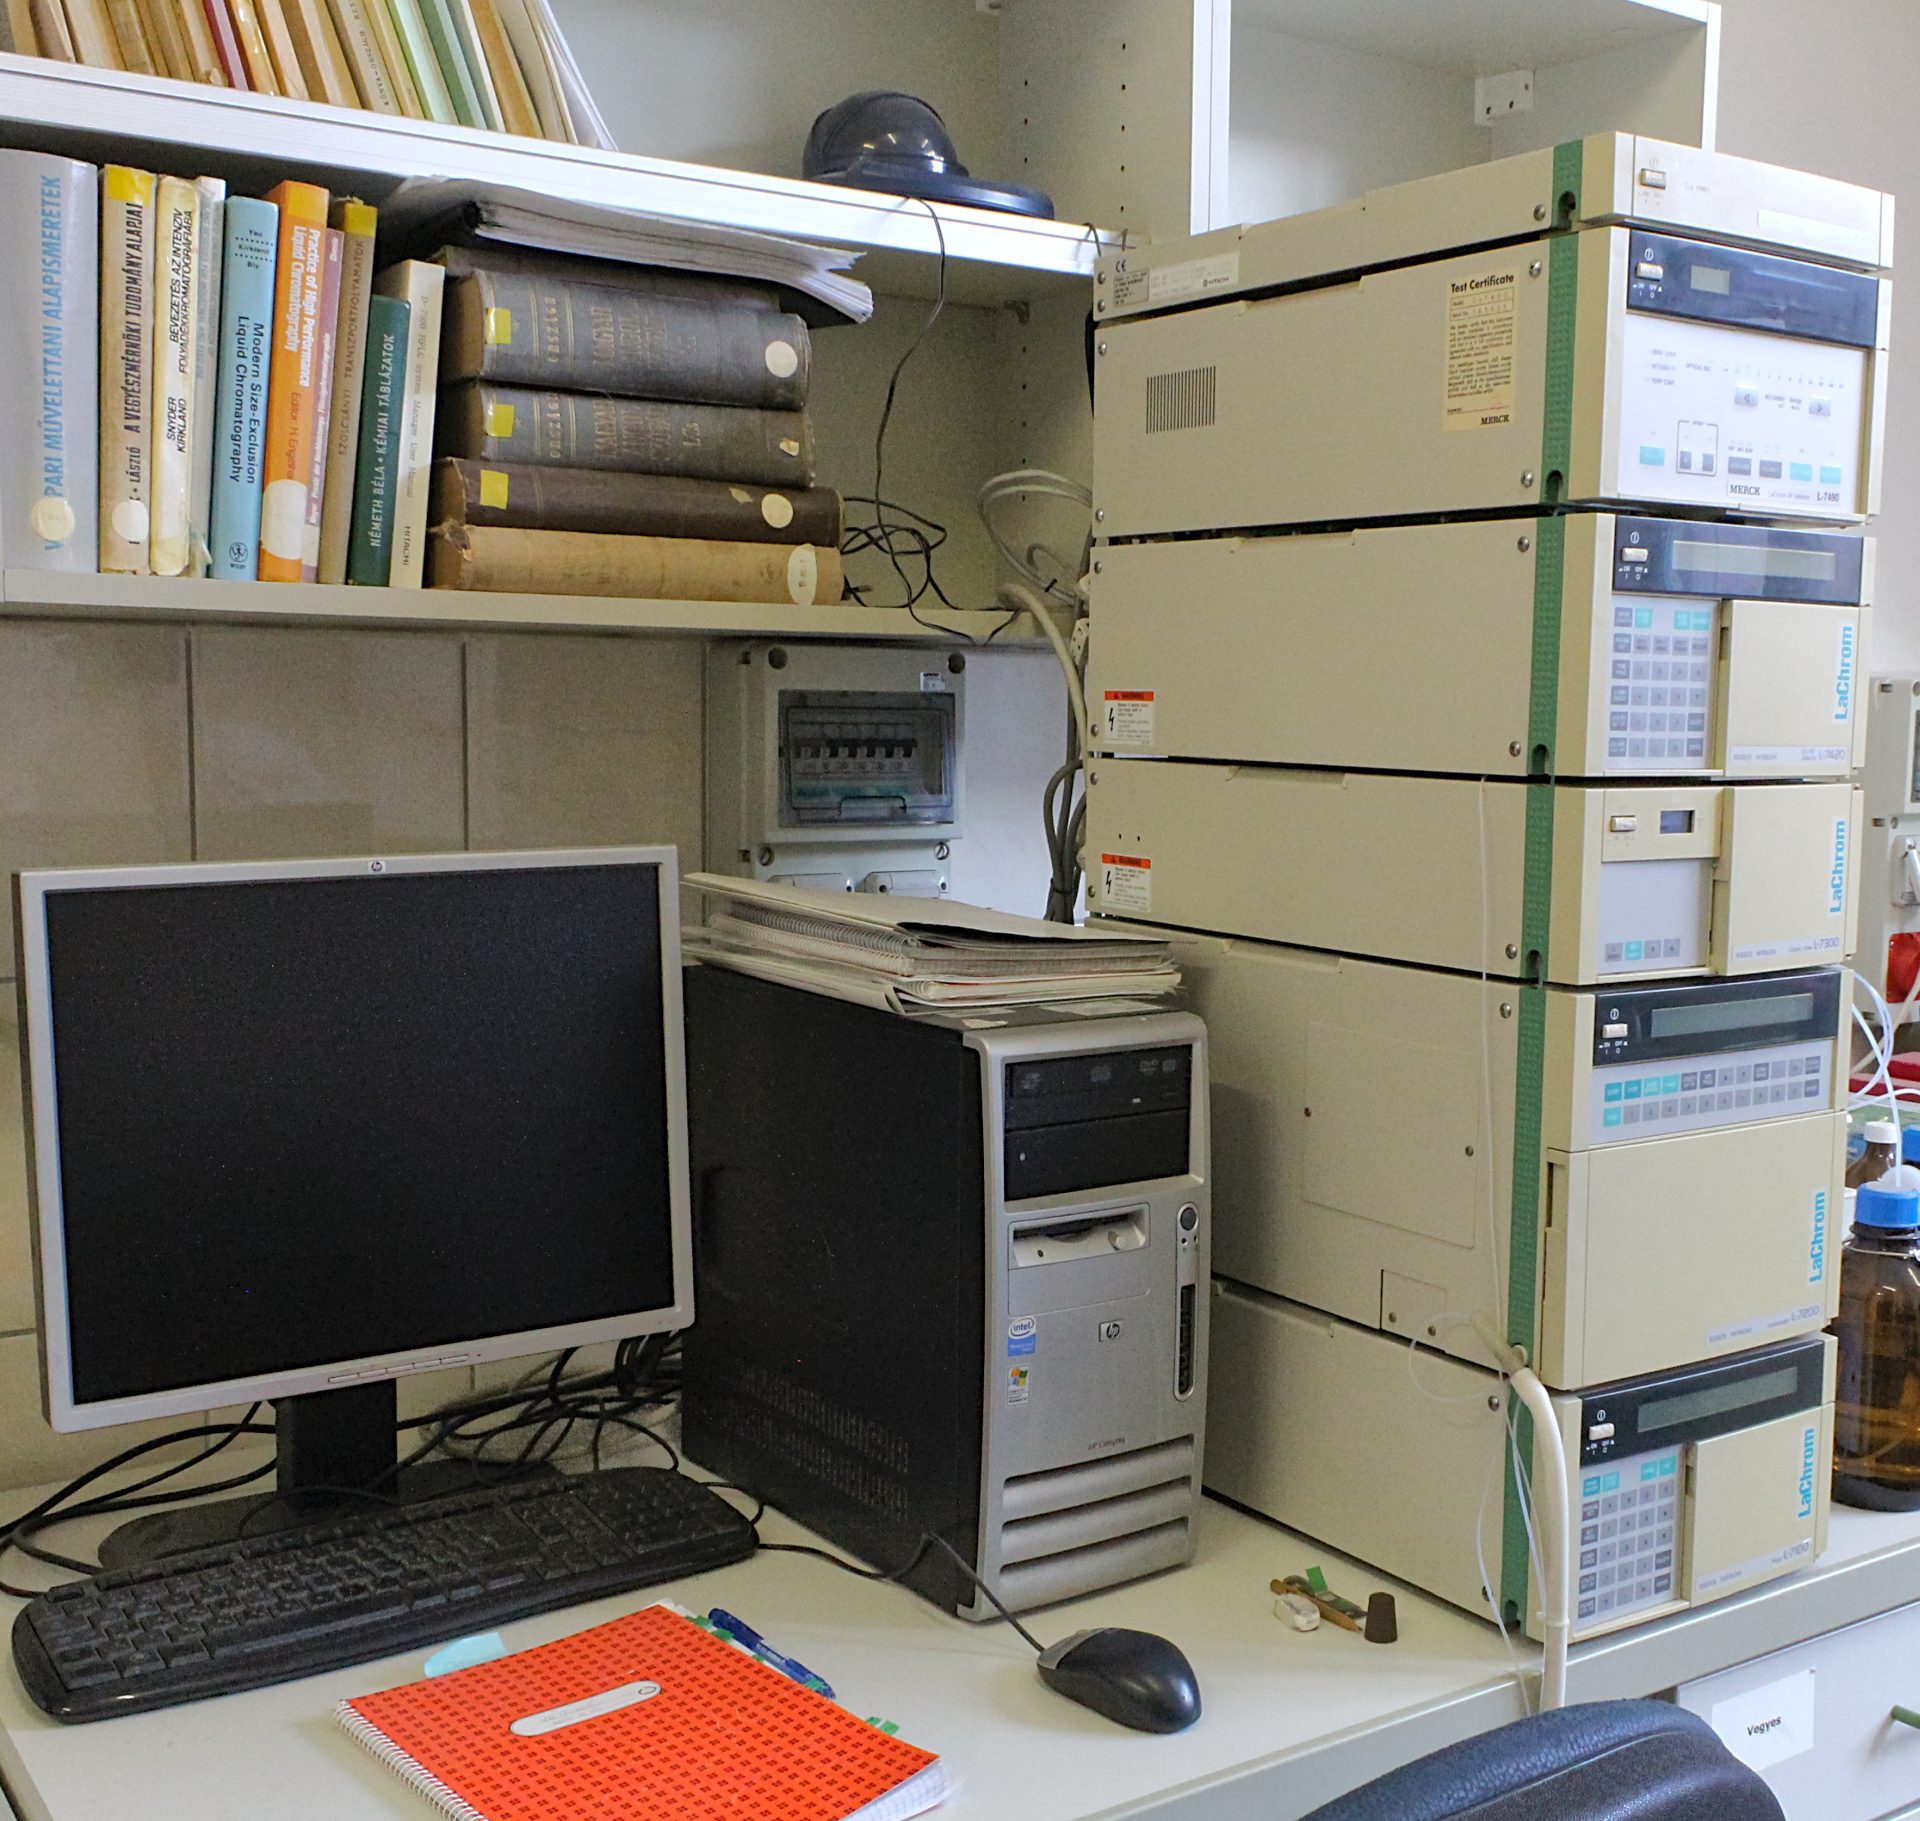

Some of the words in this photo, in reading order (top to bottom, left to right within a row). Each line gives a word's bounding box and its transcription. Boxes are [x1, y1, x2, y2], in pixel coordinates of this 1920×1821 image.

[41, 175, 63, 320] ALAPISMERETEK
[125, 202, 144, 253] ALAPJAI
[291, 225, 306, 260] Liquid
[174, 261, 182, 275] AZ
[306, 228, 321, 274] Practice
[121, 252, 143, 318] TUDOMÁNY
[303, 289, 318, 316] High
[305, 274, 319, 290] of
[1451, 282, 1467, 293] Test
[1469, 274, 1515, 290] Certificate
[169, 280, 181, 343] BEVEZETÉS
[344, 240, 365, 378] TRANSZPORTFOLYAMATOK
[235, 315, 250, 360] Liquid
[251, 322, 265, 378] Modern
[299, 317, 316, 388] Performance
[120, 321, 143, 418] VEGYÉSZMÉRNÖKI
[378, 333, 395, 407] TÁBLÁZATOK
[123, 423, 143, 434] A
[167, 396, 177, 441] SNYDER
[177, 398, 187, 453] KIRKLAND
[229, 362, 248, 483] Chromatography
[247, 382, 262, 485] Size-Exclusion
[374, 409, 389, 454] KÉMIAI
[1481, 414, 1510, 425] MERCK
[371, 465, 385, 496] BÉLA
[1729, 484, 1761, 496] MERCK
[1817, 491, 1840, 502] L-7490
[368, 500, 384, 547] NÉMETH
[403, 526, 411, 566] HITACHI
[1835, 626, 1852, 720] LaChrom
[1830, 820, 1845, 913] LaChrom
[1814, 937, 1840, 950] L-7300
[1809, 1192, 1826, 1283] LaChrom
[1013, 1321, 1031, 1332] intel
[1791, 1305, 1820, 1322] L-7200
[1088, 1442, 1098, 1451] HP
[1098, 1437, 1126, 1448] Compaq
[1798, 1428, 1815, 1518] LaChrom
[1783, 1542, 1810, 1561] L-7100
[1746, 1715, 1783, 1736] Vegyes
